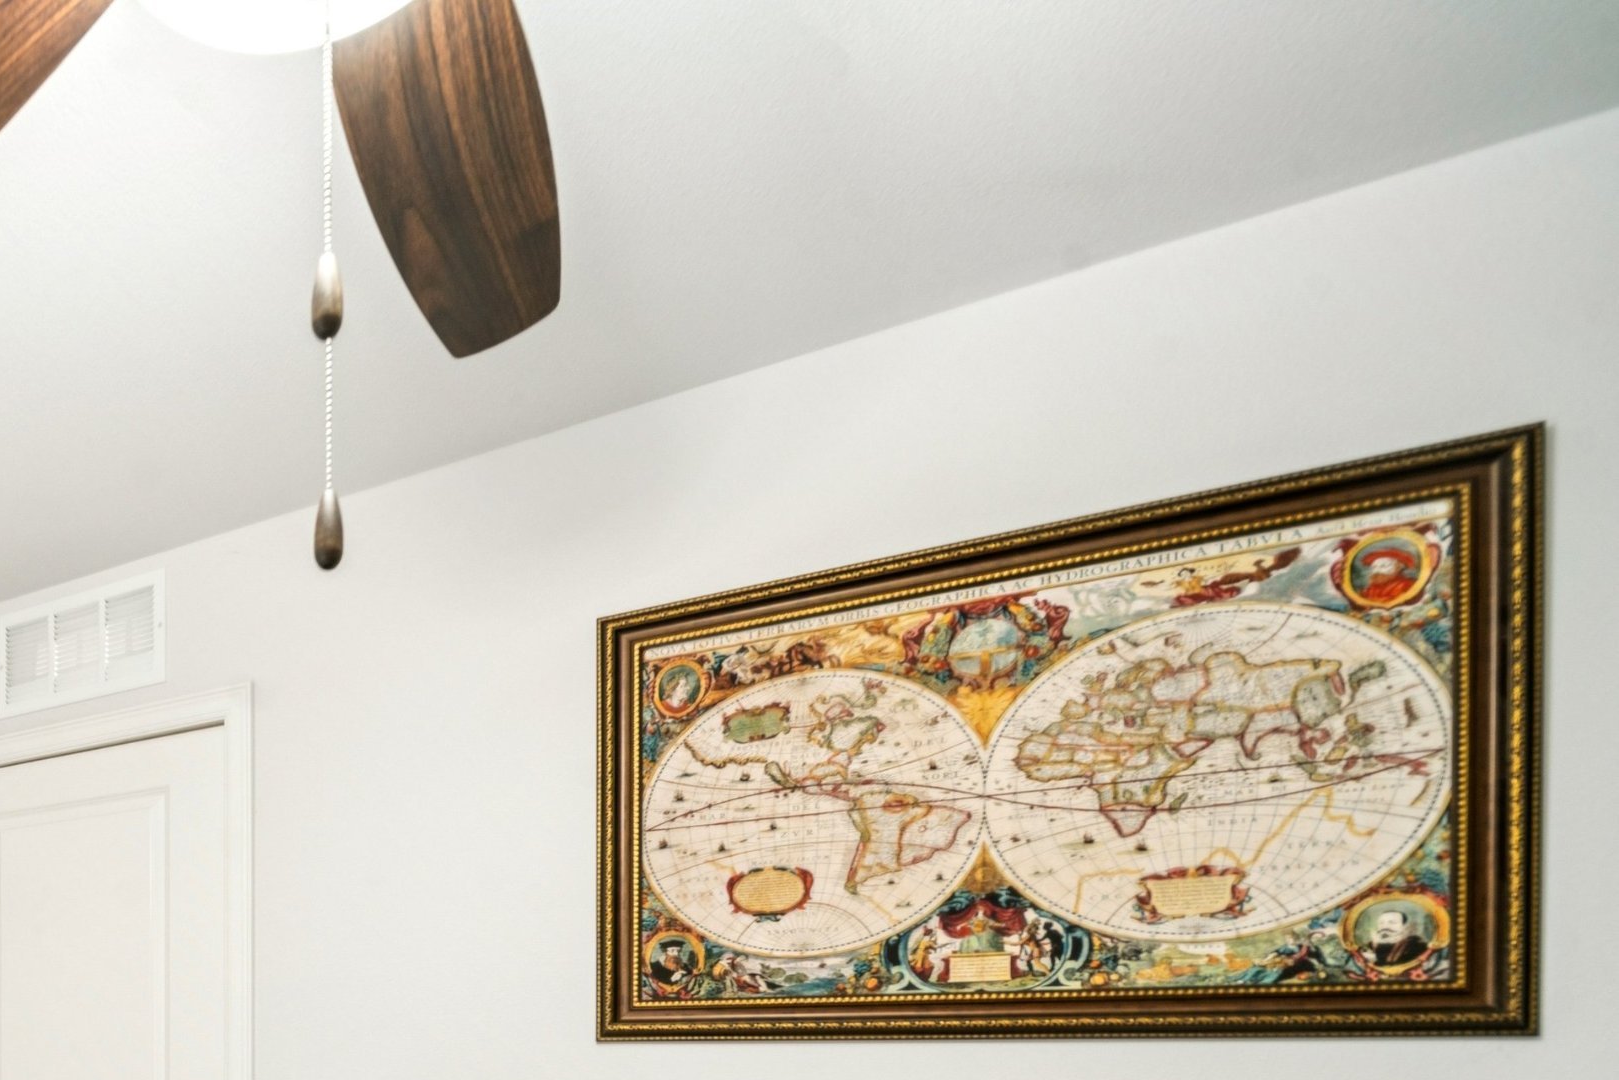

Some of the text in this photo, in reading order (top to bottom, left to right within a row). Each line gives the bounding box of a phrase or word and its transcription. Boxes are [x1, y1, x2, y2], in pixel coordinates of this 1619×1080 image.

[650, 643, 688, 657] NOVA
[834, 607, 879, 624] ORBIS
[884, 583, 1006, 614] GEOGRAPHICA
[1008, 579, 1029, 591] AC
[1039, 546, 1209, 586] HYDROGRAPHICA
[1217, 528, 1303, 553] TABVLA
